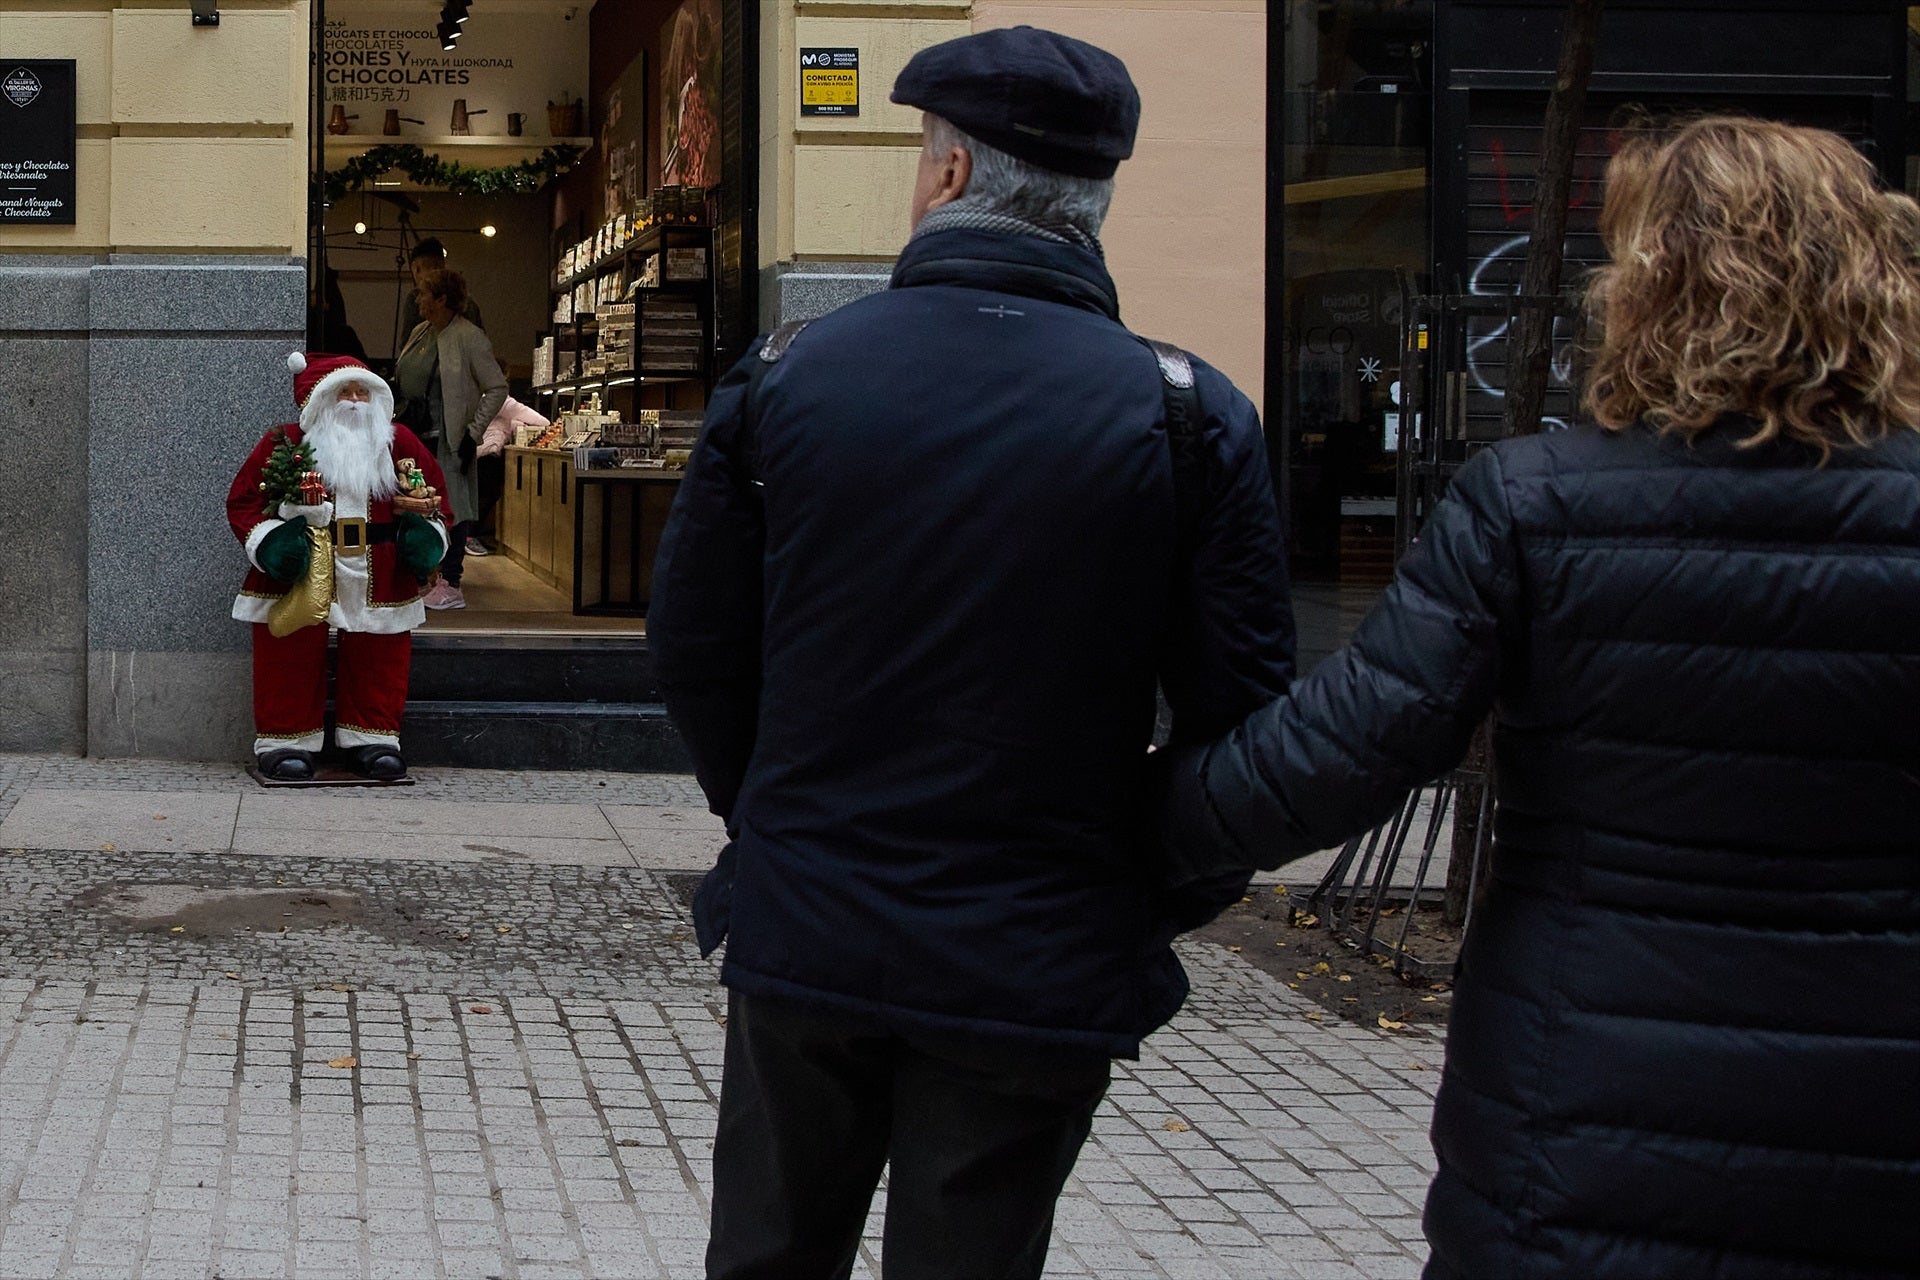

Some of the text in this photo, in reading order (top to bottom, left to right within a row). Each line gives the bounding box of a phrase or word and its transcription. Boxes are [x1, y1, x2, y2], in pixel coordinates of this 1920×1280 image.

[324, 30, 370, 39] OUGATS
[373, 30, 385, 39] ET
[324, 39, 405, 50] HOCOLATES
[397, 51, 410, 66] Y
[410, 59, 514, 68] НУГА И ШОКОЛАД
[326, 69, 470, 84] CHOCOLATES
[325, 86, 410, 102] 糖和巧克力
[15, 163, 21, 172] y
[23, 160, 69, 170] Chocolates
[24, 197, 64, 210] Nougats
[4, 207, 52, 217] Chocolates
[611, 305, 634, 314] MADRID
[604, 426, 649, 434] MADRID
